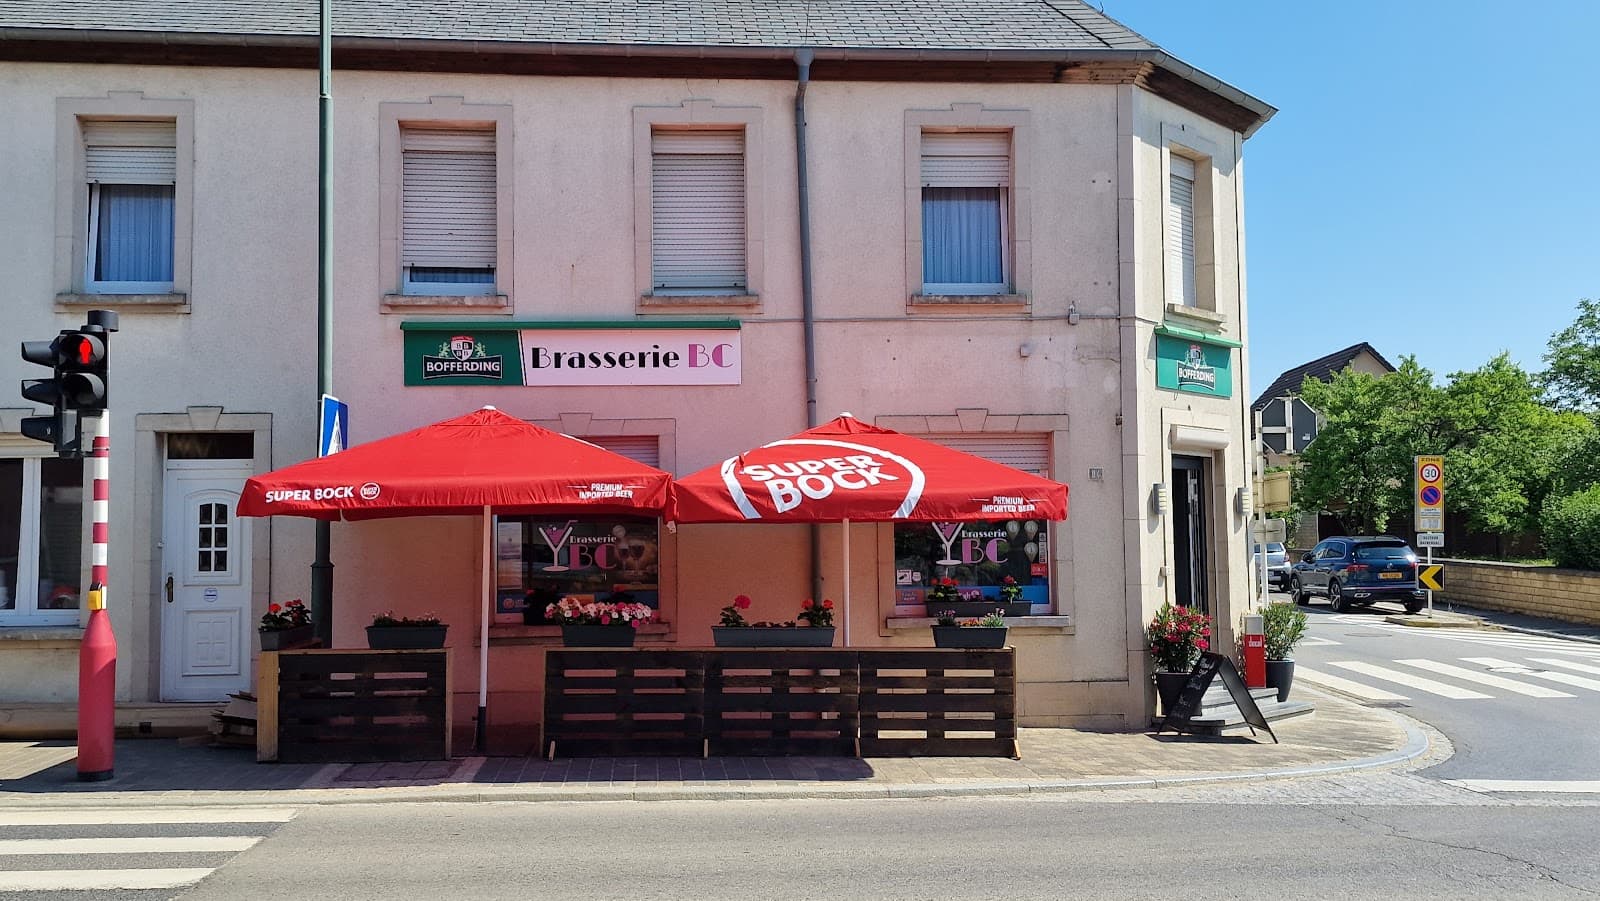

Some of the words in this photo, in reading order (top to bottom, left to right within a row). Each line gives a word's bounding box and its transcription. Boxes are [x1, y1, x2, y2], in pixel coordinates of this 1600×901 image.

[531, 344, 680, 369] Brasserie
[688, 343, 734, 368] BC
[426, 361, 500, 372] BOFFERDING
[1178, 367, 1214, 383] BOFFERDING
[740, 454, 884, 482] SUPER
[1424, 468, 1437, 478] 30
[591, 483, 624, 491] PREMIUM
[764, 466, 899, 514] BOCK
[265, 489, 311, 503] SUPER
[314, 486, 355, 500] BOCK
[578, 491, 614, 500] IMPORTED
[615, 490, 634, 498] BEER
[992, 496, 1024, 505] PREMIUM
[981, 504, 1017, 513] IMPORTED
[1018, 504, 1035, 512] BEER
[961, 528, 1008, 538] Brasserie
[569, 534, 617, 544] Brasserie
[961, 537, 1008, 564] BC
[569, 544, 617, 570] BC
